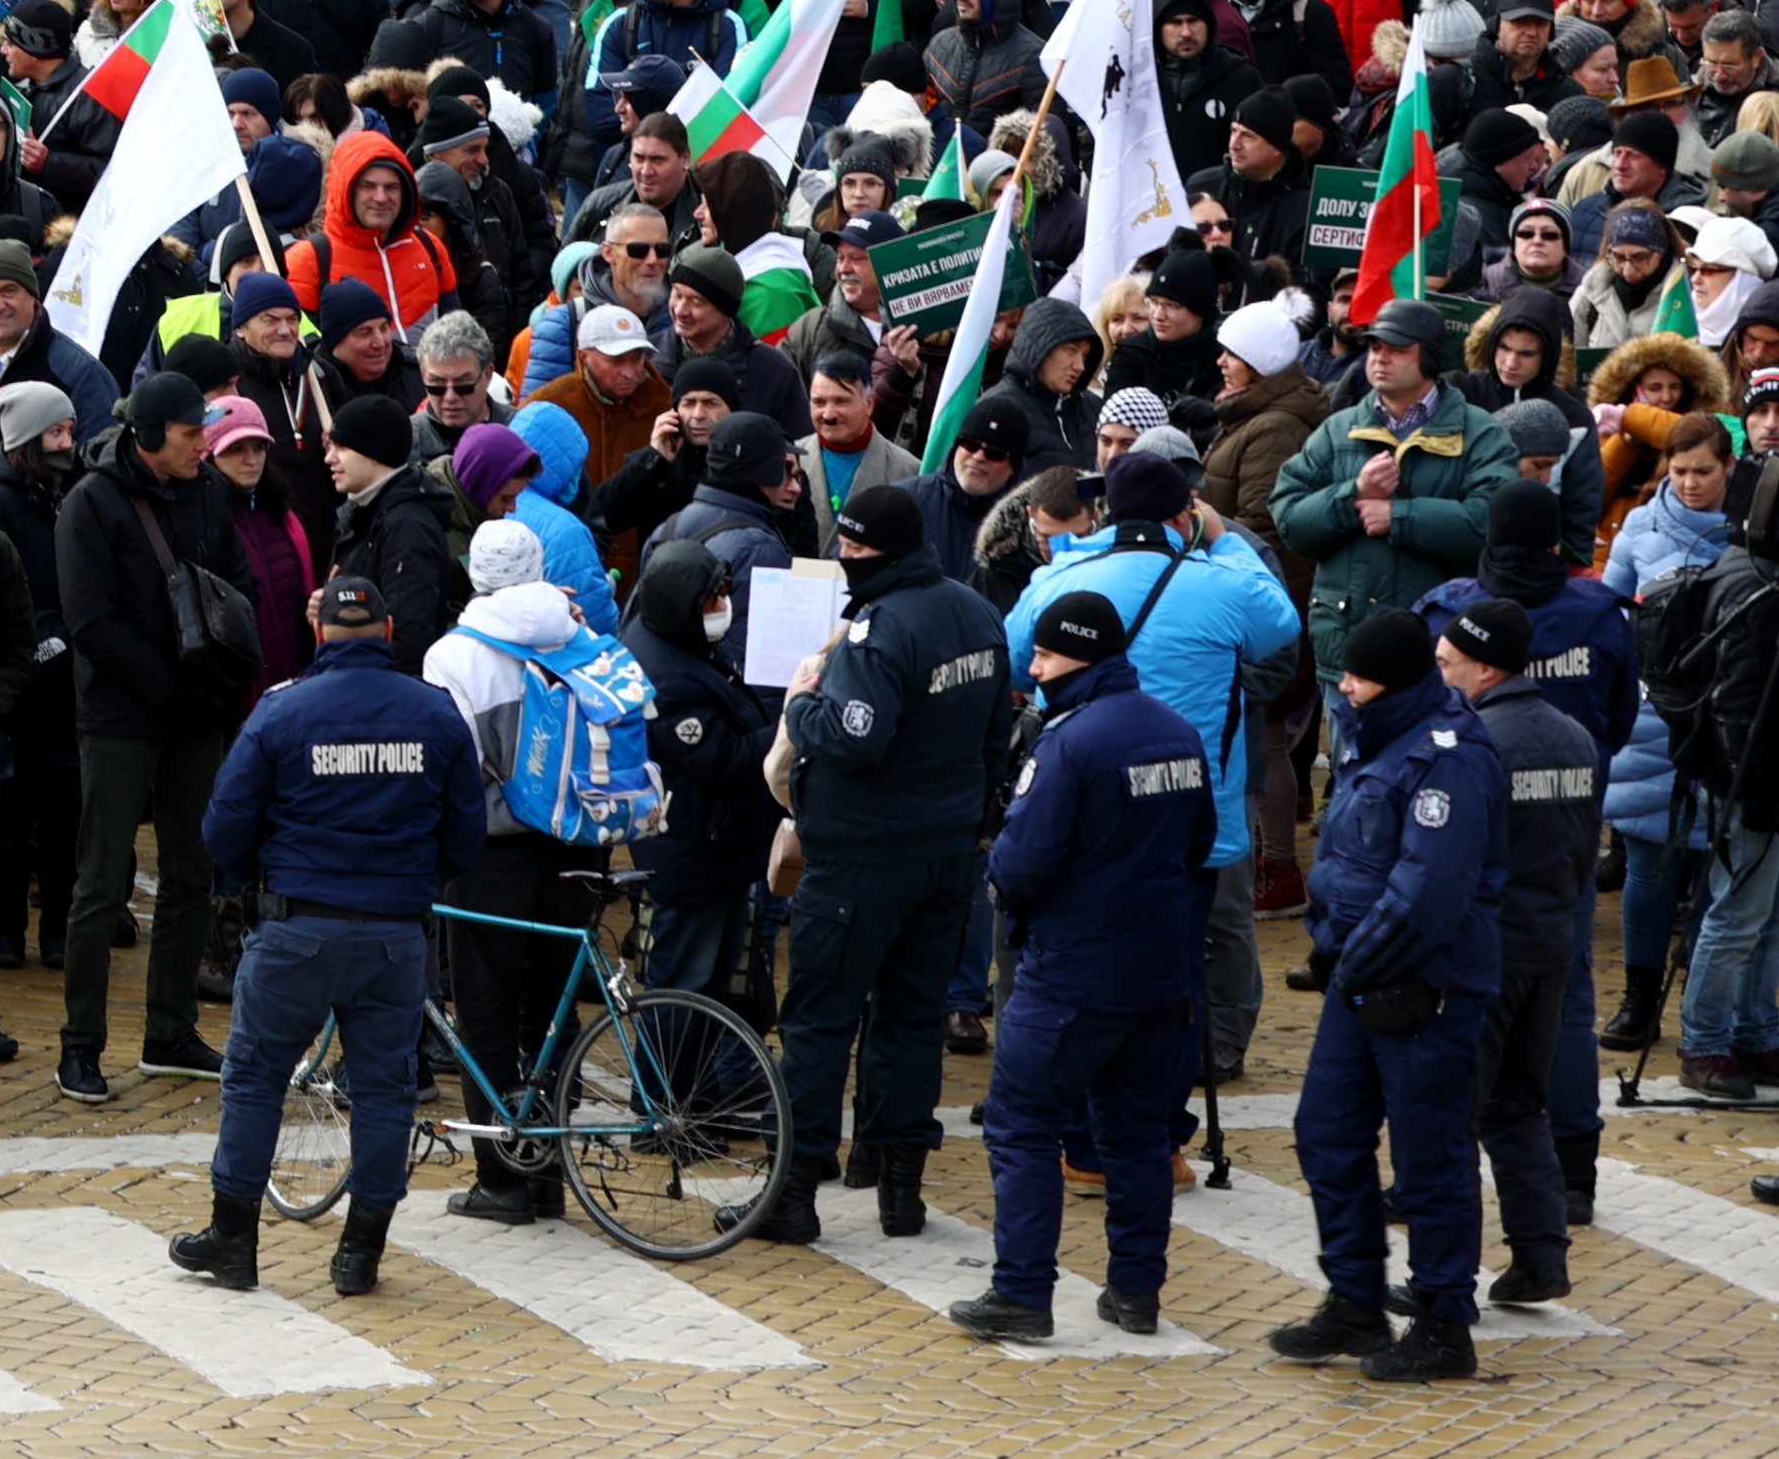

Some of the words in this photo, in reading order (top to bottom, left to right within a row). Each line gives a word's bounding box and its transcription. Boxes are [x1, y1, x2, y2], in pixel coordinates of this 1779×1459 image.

[1315, 196, 1357, 218] ДОЛУ
[882, 265, 932, 289] КРИЗАТА
[932, 261, 940, 273] Е
[891, 301, 907, 315] НЕ
[908, 296, 923, 311] ВИ
[1059, 620, 1100, 640] POLICE
[1458, 616, 1491, 643] POLICE
[1545, 646, 1591, 679] POLICE
[311, 745, 376, 776] SECURITY
[378, 743, 424, 773] POLICE
[1511, 769, 1557, 802] SECURITY
[1557, 767, 1594, 799] POLICE
